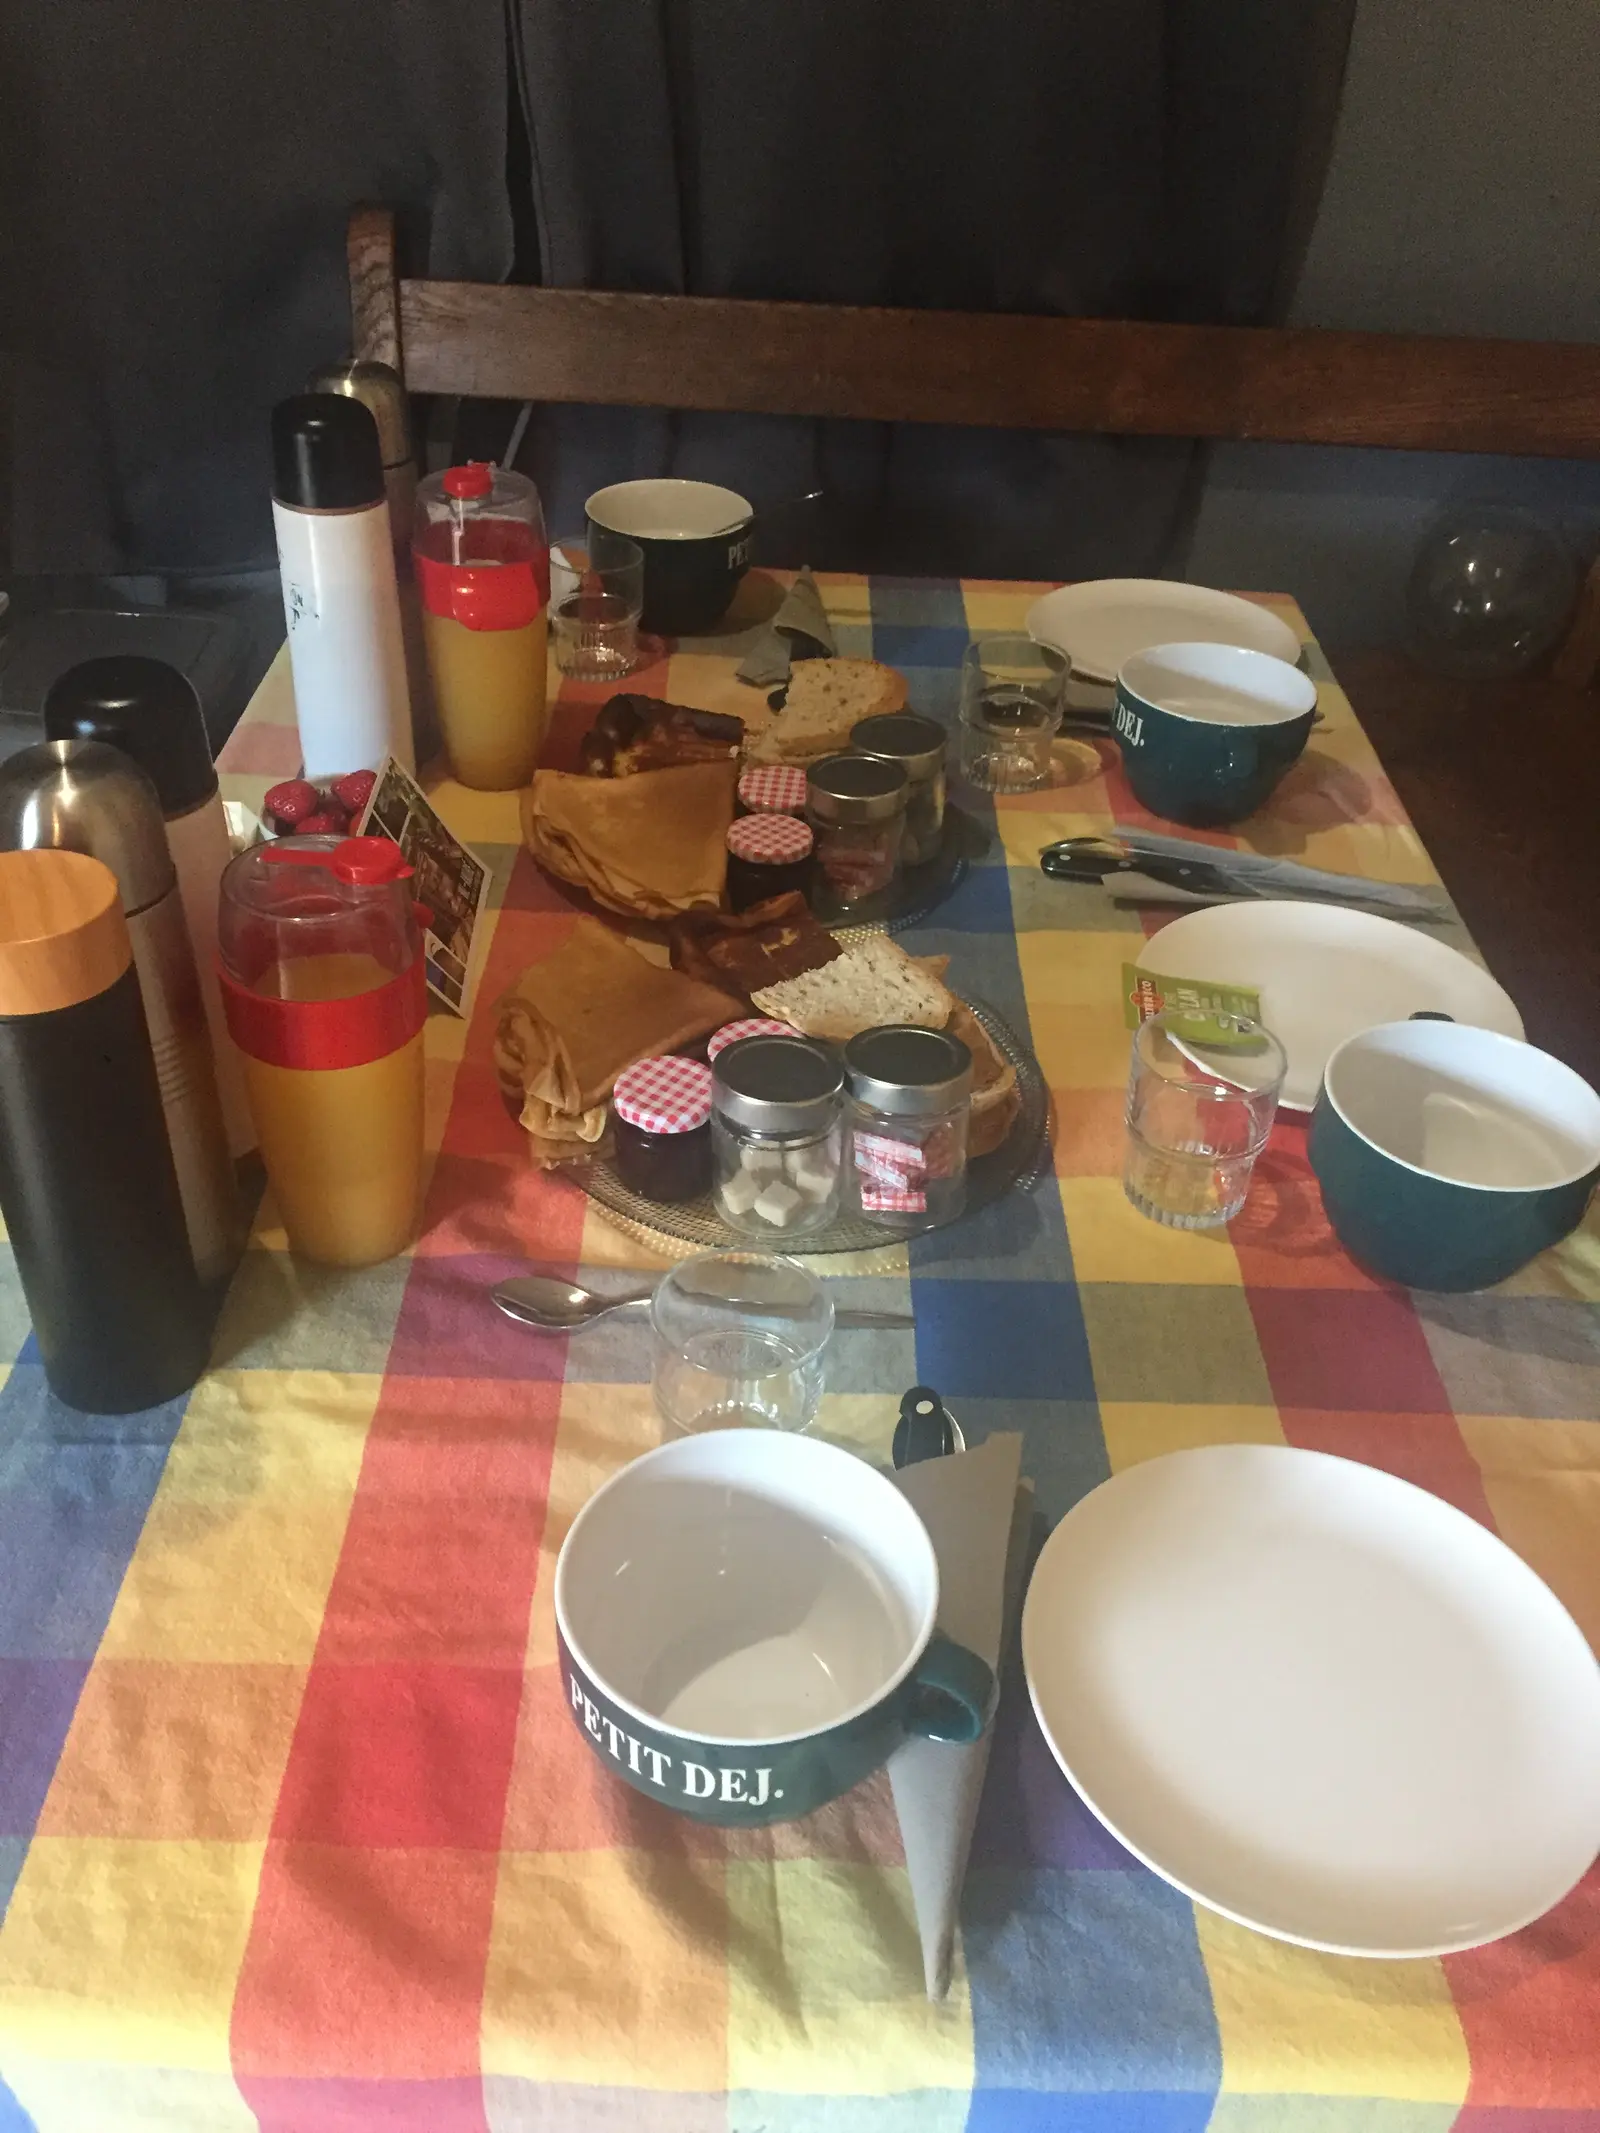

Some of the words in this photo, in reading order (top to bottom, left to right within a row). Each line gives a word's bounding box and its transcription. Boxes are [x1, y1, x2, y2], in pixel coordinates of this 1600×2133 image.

[1116, 702, 1145, 747] DEJ.
[569, 1673, 671, 1787] PETIT
[682, 1760, 784, 1806] DEJ.
